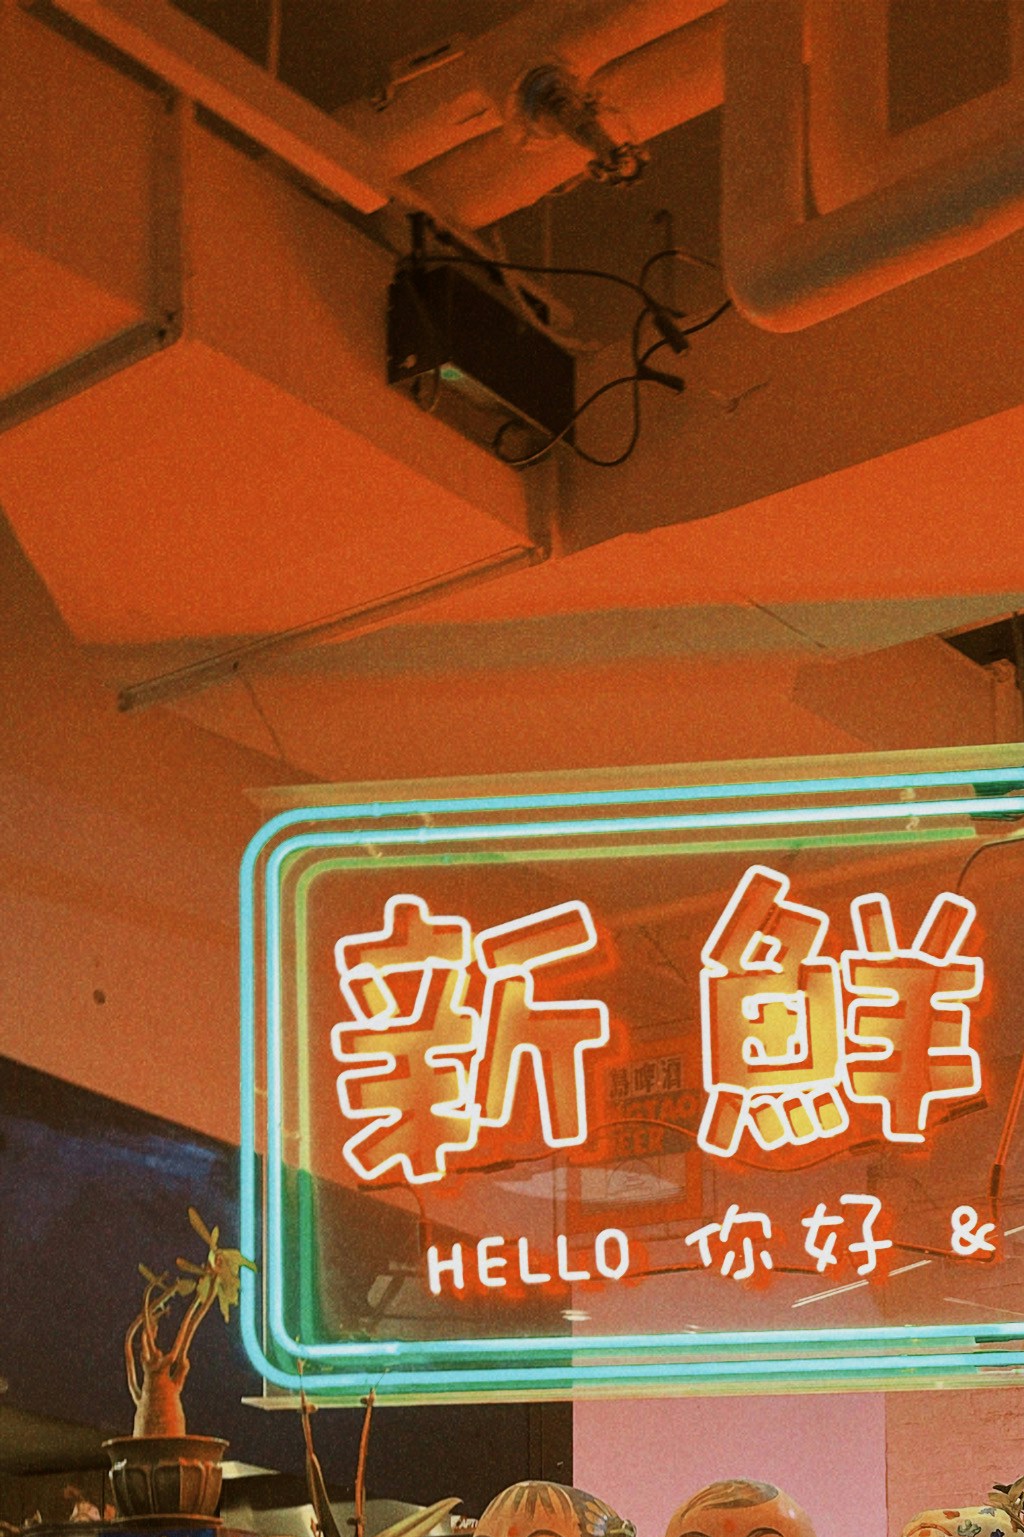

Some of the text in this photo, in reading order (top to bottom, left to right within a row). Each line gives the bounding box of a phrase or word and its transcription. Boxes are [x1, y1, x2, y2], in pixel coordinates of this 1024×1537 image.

[428, 1193, 996, 1296] HELLO 你好 &
